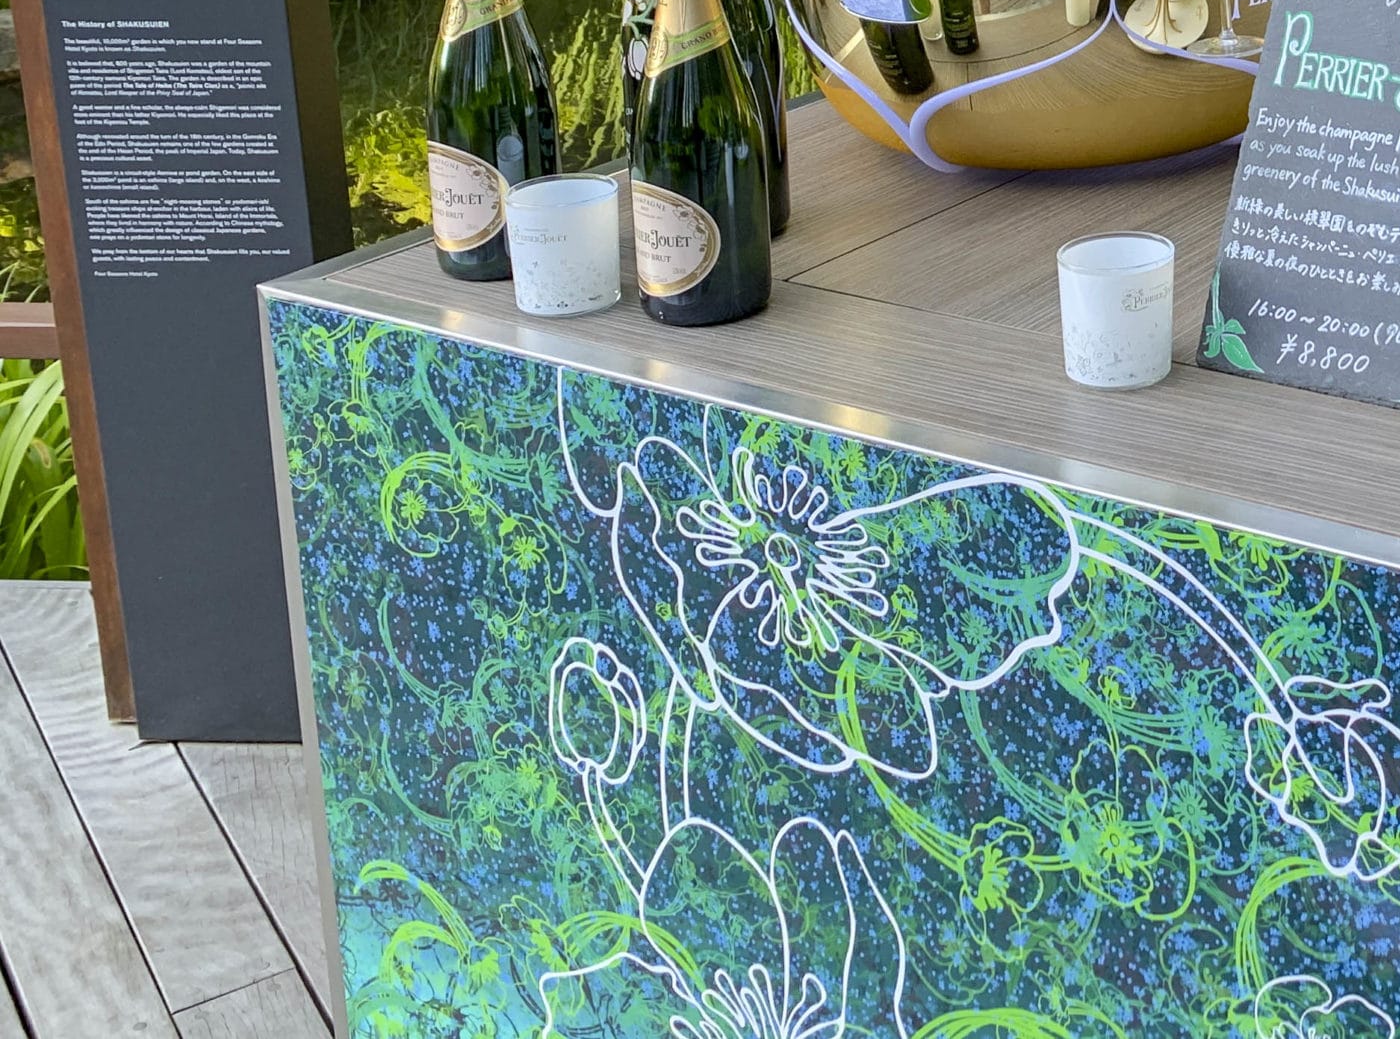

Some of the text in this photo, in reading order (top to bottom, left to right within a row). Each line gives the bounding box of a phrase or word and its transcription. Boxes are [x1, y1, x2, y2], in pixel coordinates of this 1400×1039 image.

[1256, 107, 1294, 138] Enjoy
[1296, 115, 1316, 135] the
[1318, 118, 1393, 151] champagne
[1250, 138, 1265, 151] as
[1266, 141, 1291, 159] you
[1295, 143, 1326, 162] soak
[1327, 151, 1345, 173] up
[1346, 151, 1367, 170] the
[1369, 154, 1400, 176] lush
[1242, 162, 1302, 190] greenery
[1303, 168, 1318, 189] of
[1320, 172, 1341, 193] the
[1247, 298, 1297, 323] 16:00
[1317, 315, 1371, 338] 20:00
